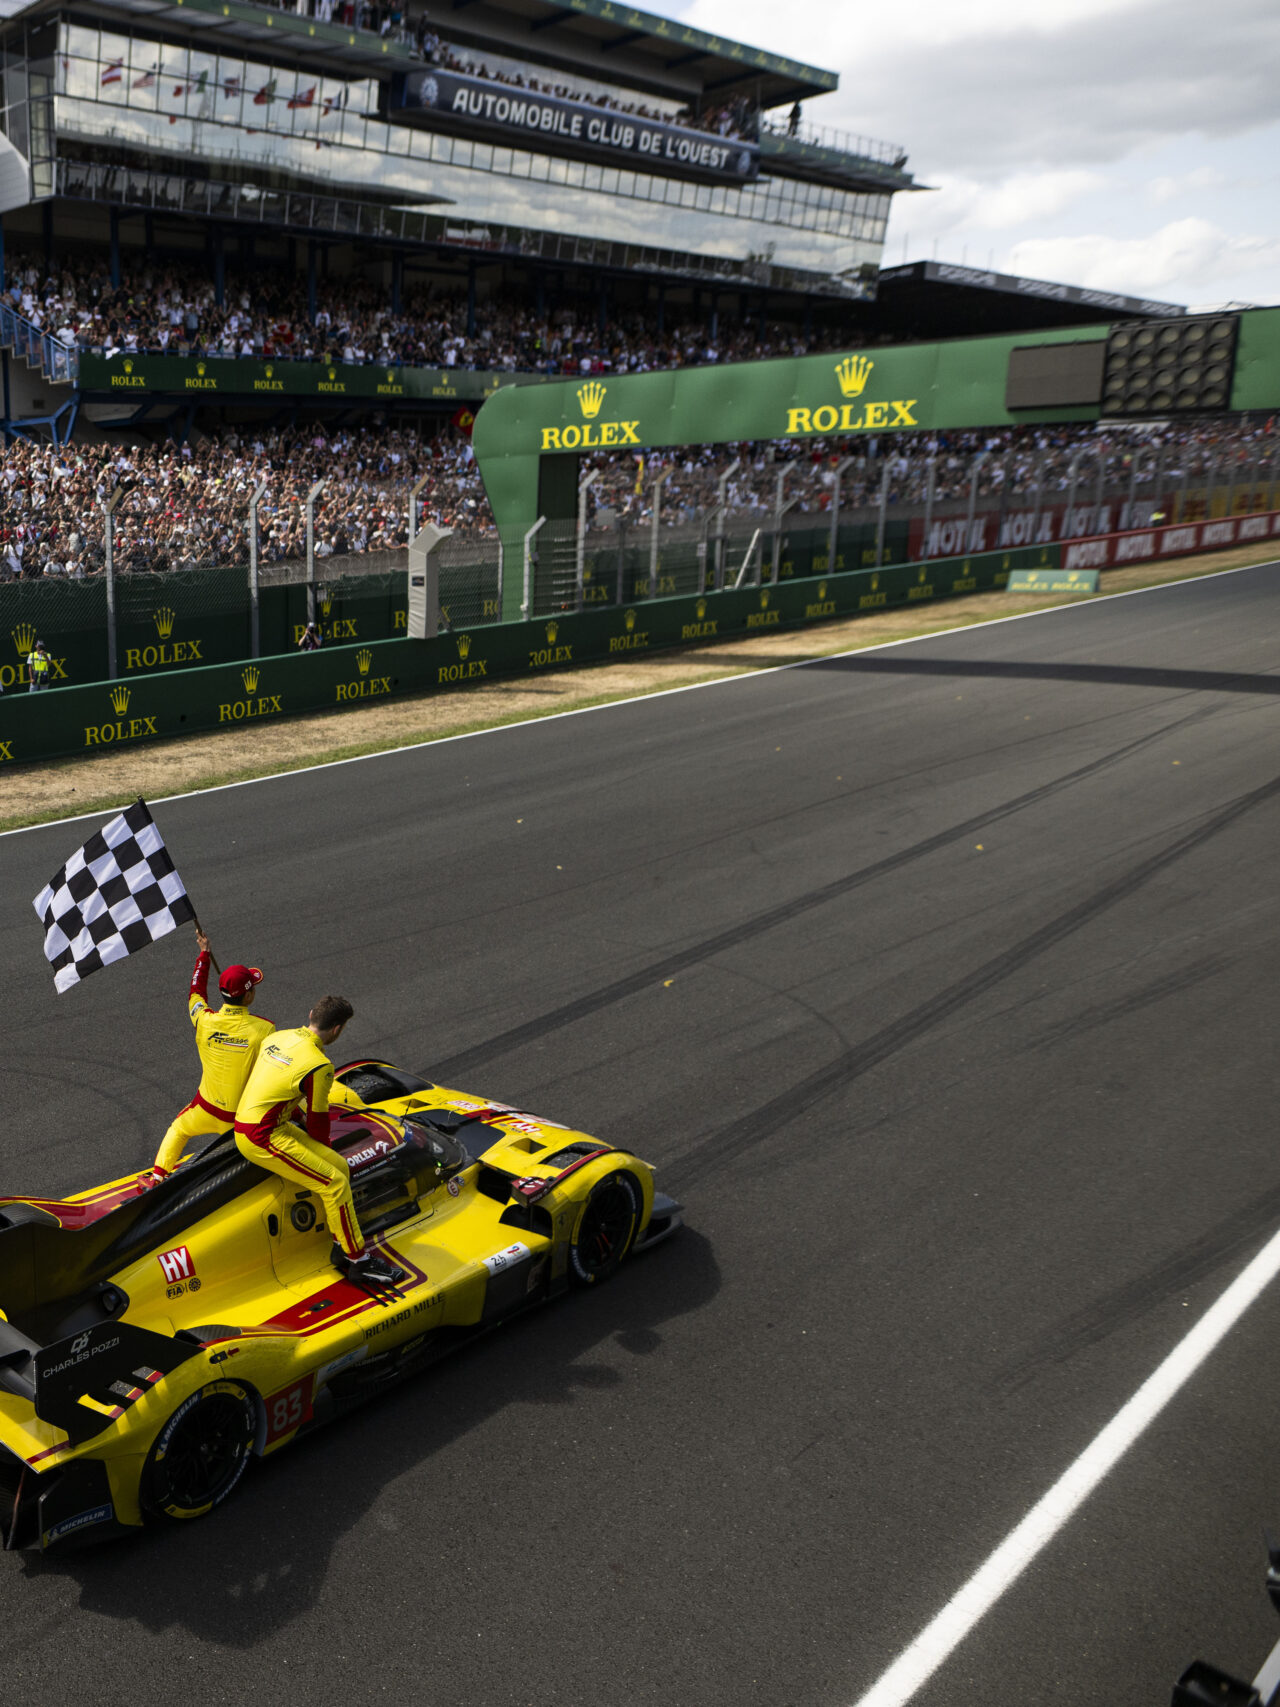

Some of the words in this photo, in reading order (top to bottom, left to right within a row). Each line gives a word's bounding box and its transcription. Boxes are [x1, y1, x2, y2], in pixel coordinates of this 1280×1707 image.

[452, 87, 581, 137] AUTOMOBILE
[587, 118, 634, 149] CLUB
[639, 129, 662, 155] DE
[665, 137, 730, 169] L'OUEST
[111, 375, 146, 387] ROLEX
[185, 377, 217, 389] ROLEX
[254, 380, 284, 391] ROLEX
[318, 382, 346, 392] ROLEX
[377, 384, 403, 394] ROLEX
[786, 399, 918, 435] ROLEX
[541, 420, 641, 450] ROLEX
[747, 609, 781, 629] ROLEX
[805, 601, 836, 618] ROLEX
[293, 618, 358, 643] REX
[681, 620, 718, 640] ROLEX
[126, 639, 203, 669] ROLEX
[437, 659, 488, 684] ROLEX
[336, 675, 391, 702] ROLEX
[219, 695, 282, 722] ROLEX
[84, 716, 158, 746] ROLEX
[346, 1147, 377, 1167] ORLEN
[159, 1247, 190, 1282] HY
[167, 1286, 183, 1298] FIA
[365, 1309, 411, 1339] RICHARD
[414, 1292, 447, 1315] MILLE
[43, 1351, 90, 1378] CHARLES
[91, 1337, 120, 1356] POZZI
[163, 1393, 199, 1441] MICHELIN
[273, 1388, 302, 1432] 83
[59, 1510, 106, 1533] MICHELIN
